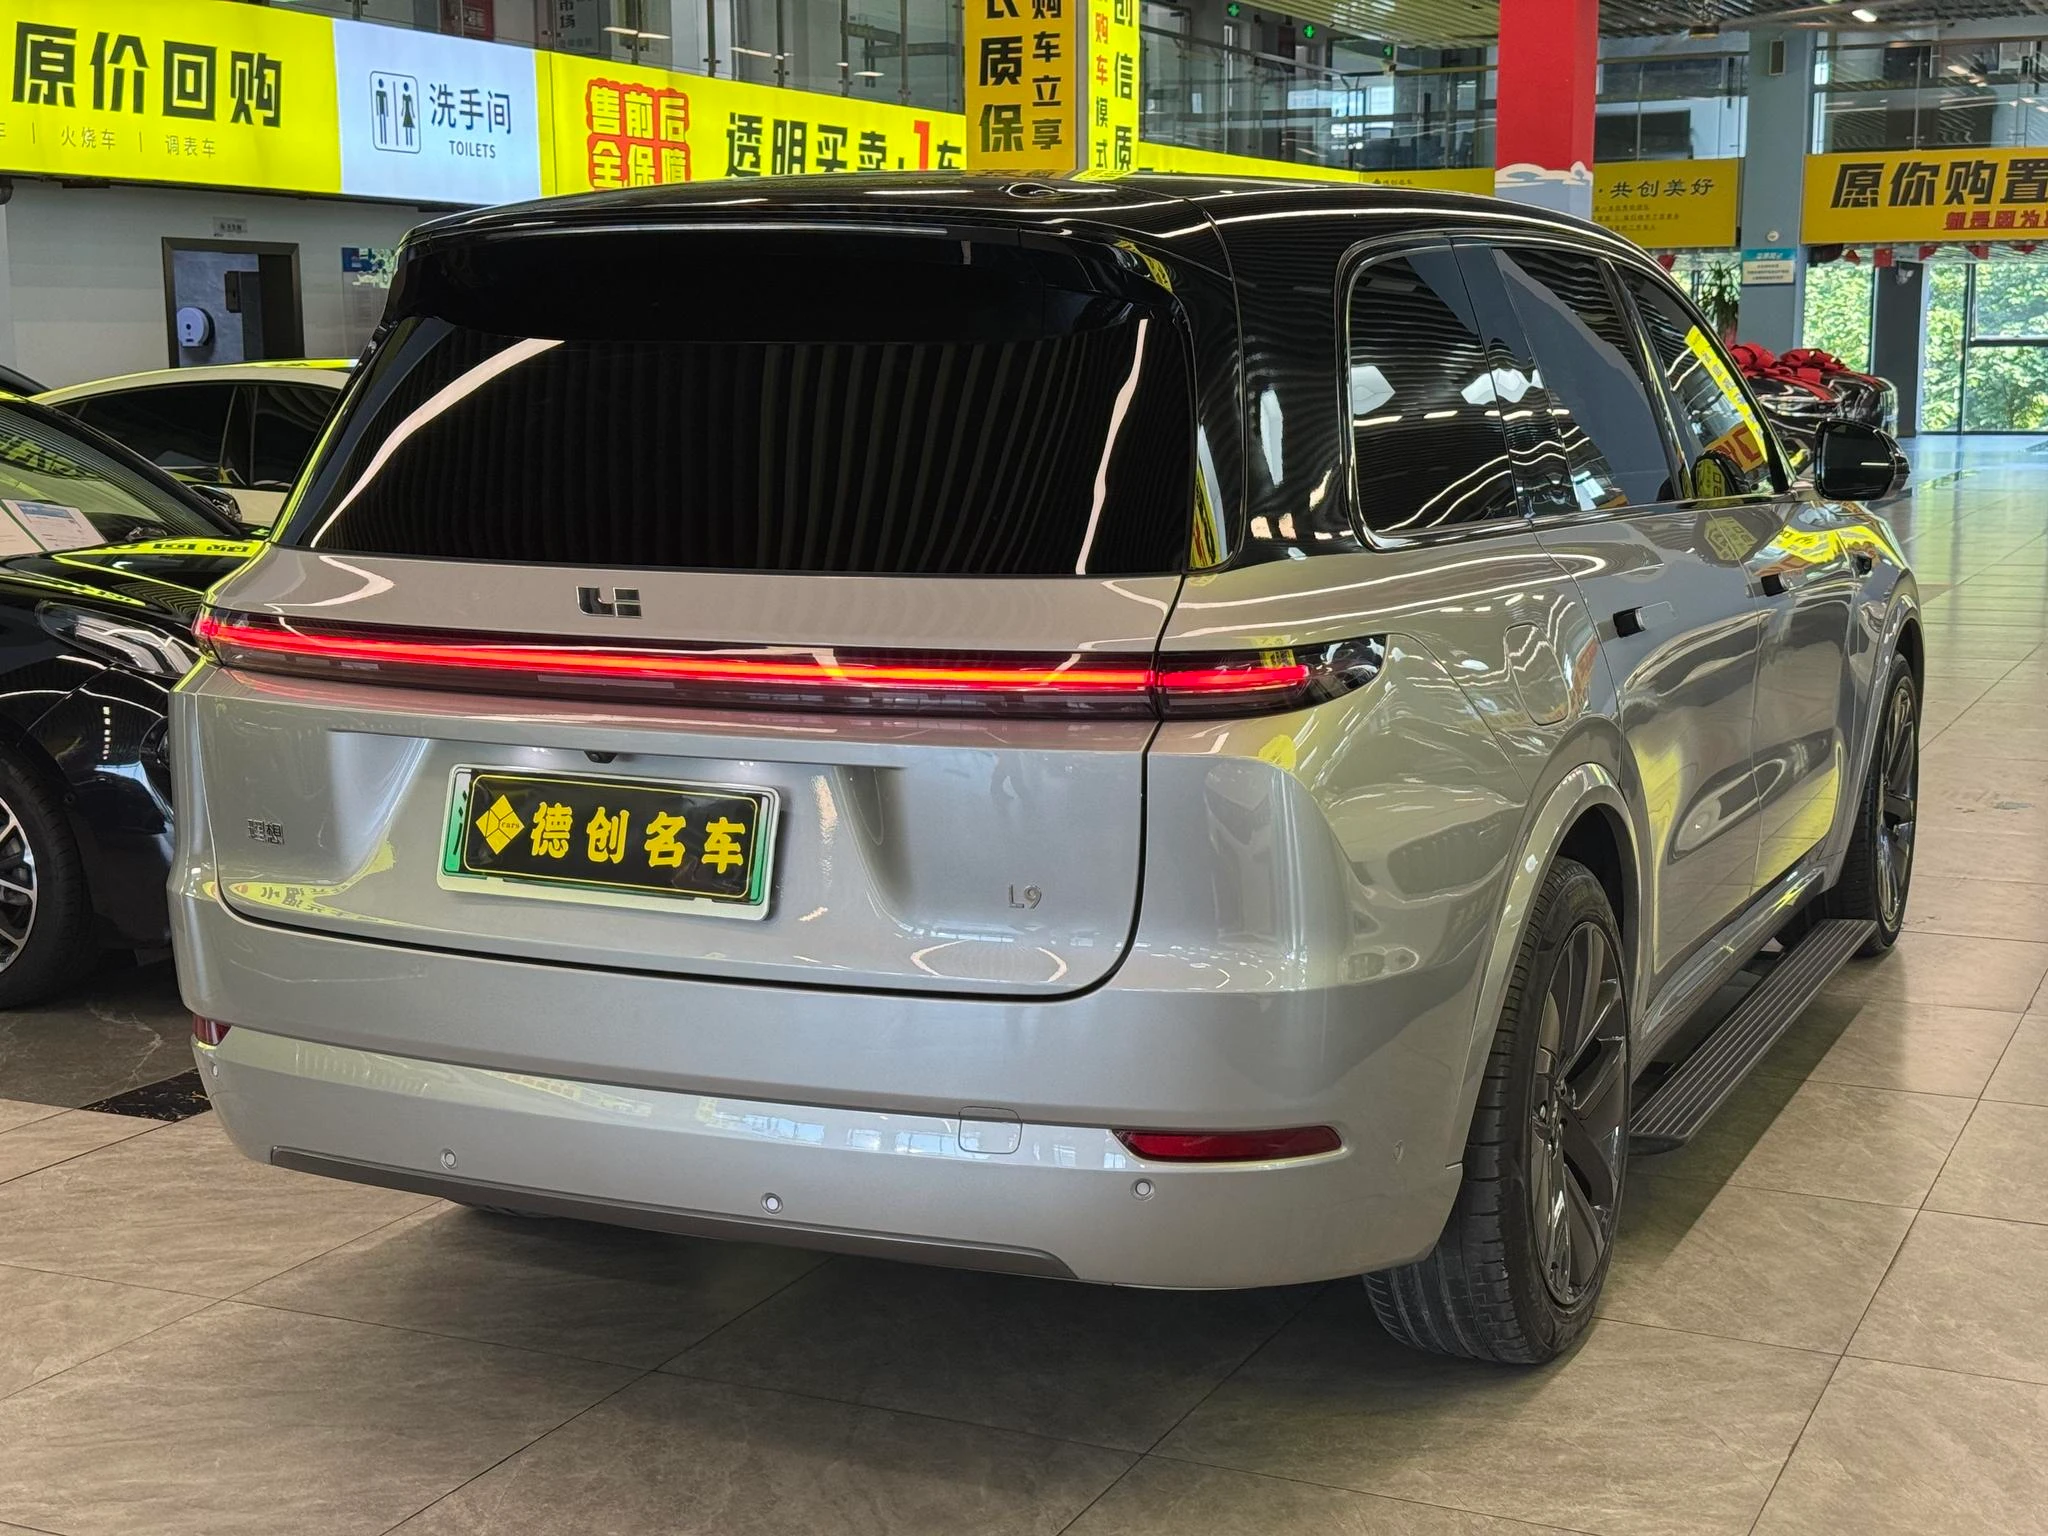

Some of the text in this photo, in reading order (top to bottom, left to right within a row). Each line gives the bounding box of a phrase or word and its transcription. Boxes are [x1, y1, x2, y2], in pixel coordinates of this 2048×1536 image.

[12, 21, 282, 128] 原价回购
[1096, 0, 1109, 168] 购车模式
[428, 83, 512, 135] 洗手间
[589, 84, 687, 143] 售前后
[61, 126, 216, 157] 火烧车 调表车
[449, 140, 497, 158] TOILETS
[1830, 160, 2048, 209] 愿你购置
[1946, 210, 2048, 229] 就是因为
[247, 819, 285, 845] 理想
[531, 801, 747, 874] 德创名车
[1008, 883, 1042, 909] L9
